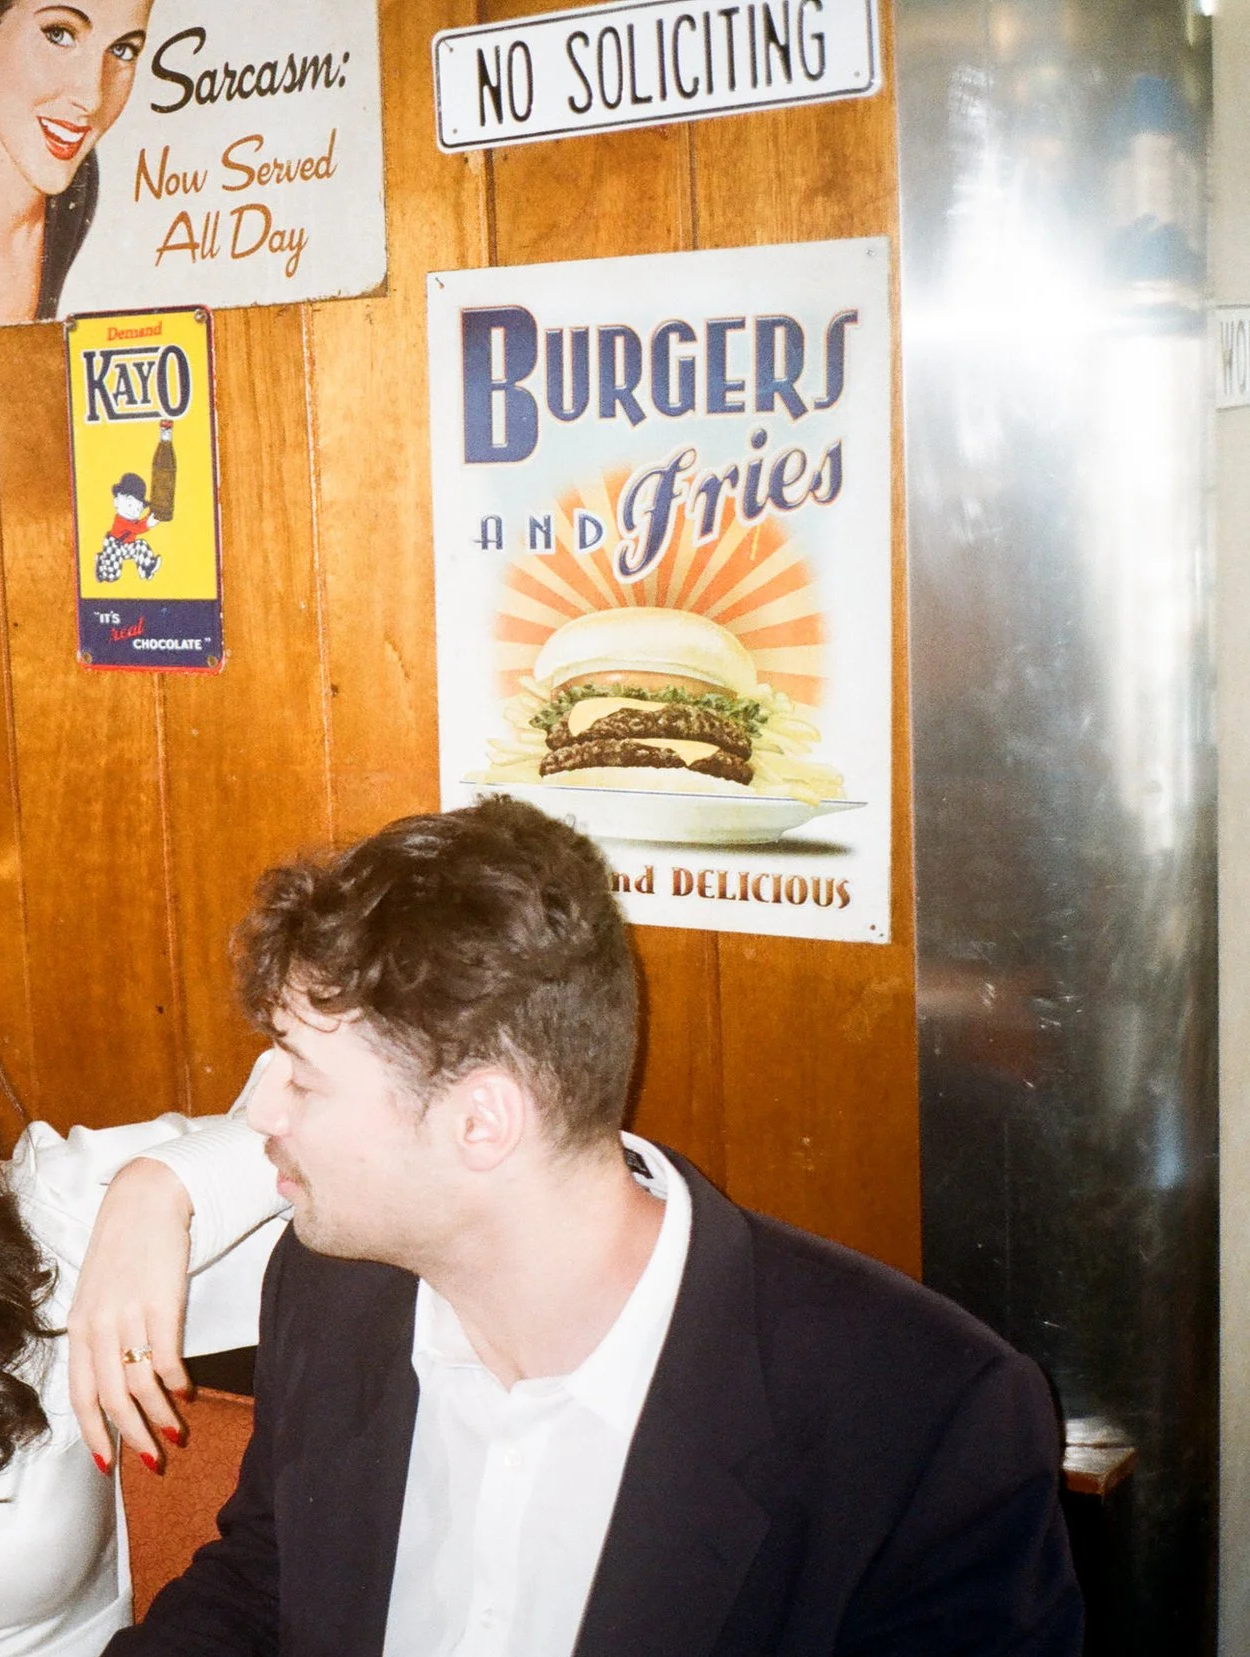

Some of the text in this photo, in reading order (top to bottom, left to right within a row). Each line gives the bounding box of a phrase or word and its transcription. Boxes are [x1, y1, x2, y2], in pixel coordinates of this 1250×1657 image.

[150, 26, 350, 114] Sarcasm:
[477, 0, 826, 127] NO SOLICITING
[135, 128, 337, 202] Now Served
[154, 203, 307, 278] All Day
[107, 321, 163, 341] Demand
[1220, 318, 1250, 396] WO
[83, 345, 191, 421] KAYO
[461, 305, 859, 465] BURGERS
[474, 513, 604, 550] AND
[618, 427, 843, 577] Fries
[612, 866, 851, 909] nd DELICIOUS
